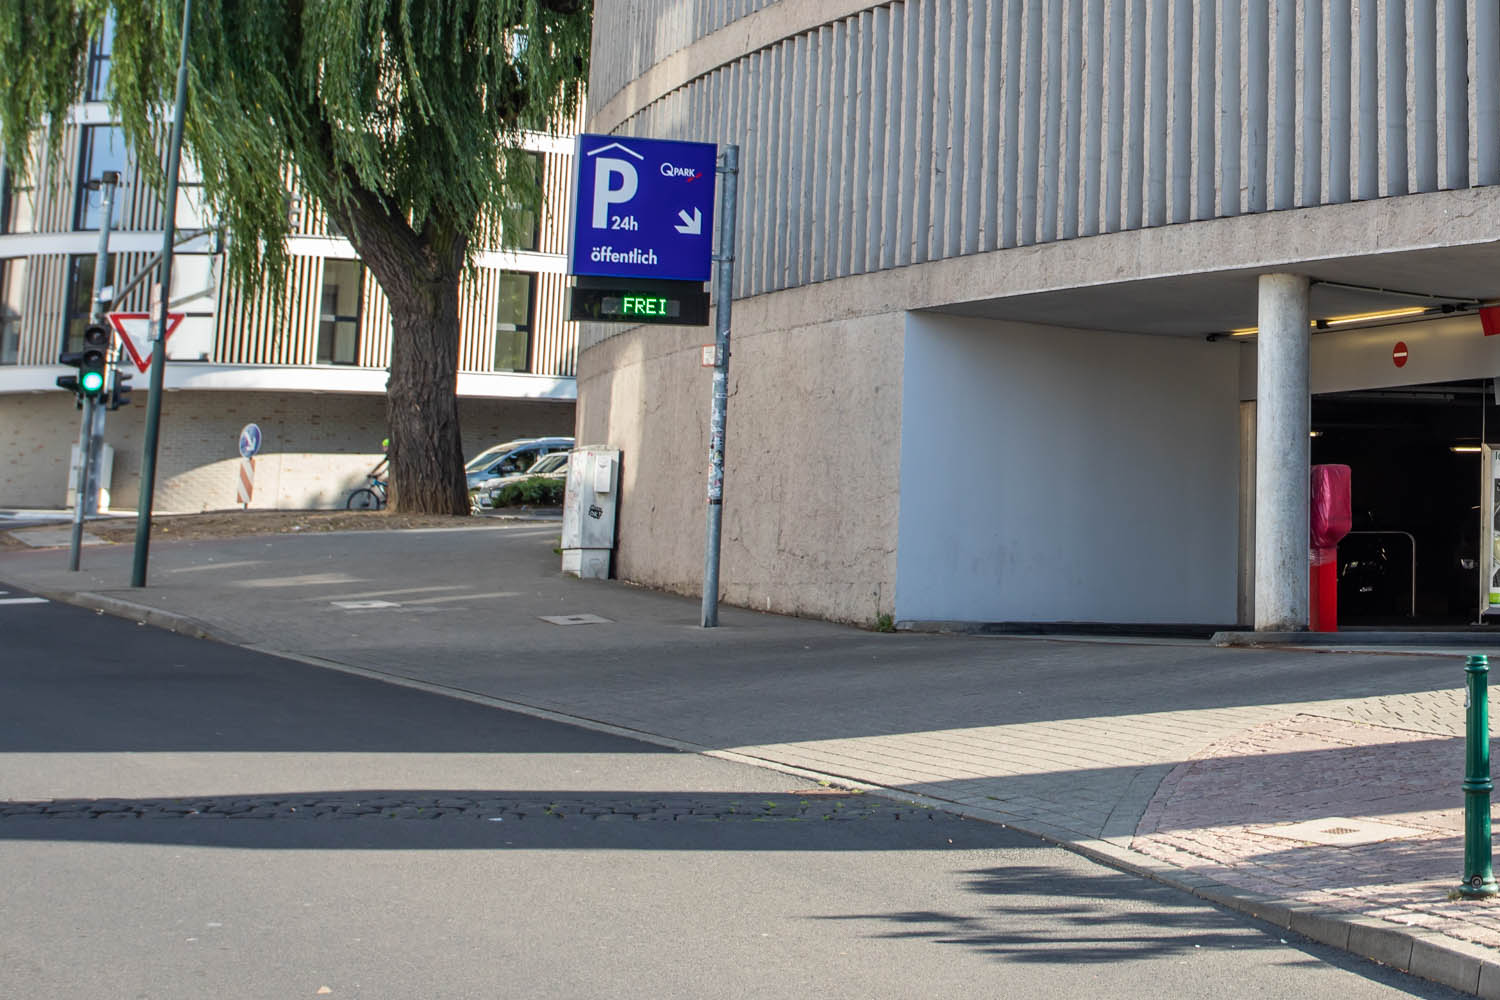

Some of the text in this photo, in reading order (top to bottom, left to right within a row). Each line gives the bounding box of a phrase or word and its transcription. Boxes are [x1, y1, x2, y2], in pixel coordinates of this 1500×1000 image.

[592, 157, 639, 229] P
[611, 215, 639, 231] 24h
[590, 246, 658, 265] öffentlich
[623, 297, 667, 315] FREI
